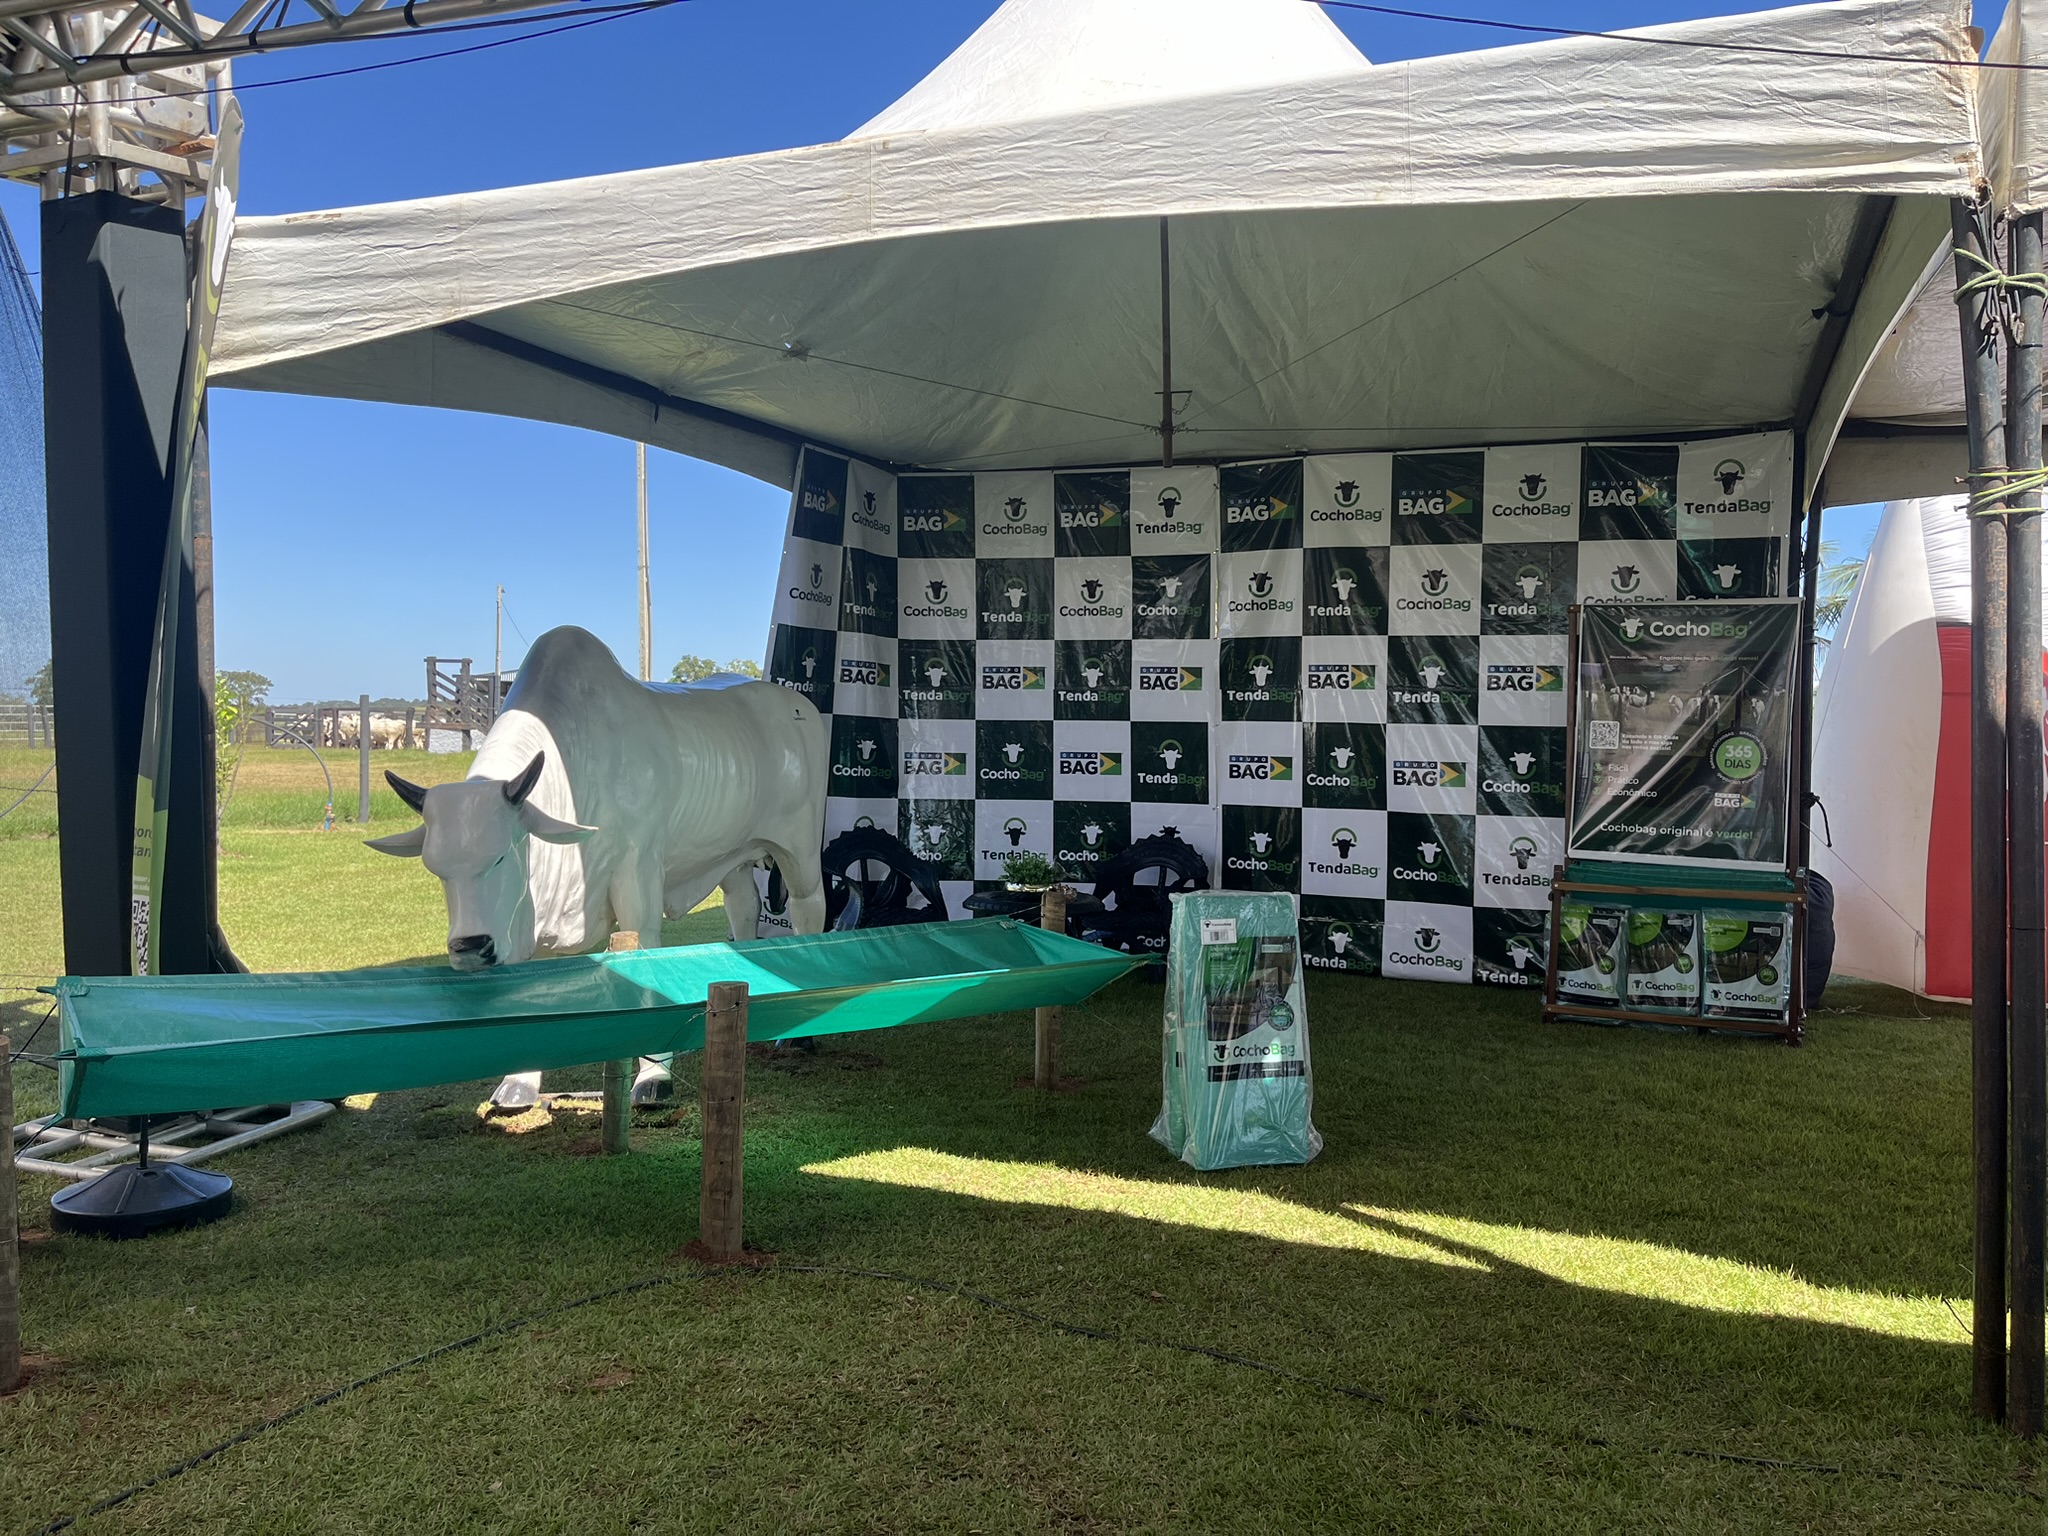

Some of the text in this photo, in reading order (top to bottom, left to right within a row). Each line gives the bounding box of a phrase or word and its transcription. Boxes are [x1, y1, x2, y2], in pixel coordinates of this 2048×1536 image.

[804, 491, 826, 512] BAG
[1588, 488, 1637, 508] BAG
[1227, 504, 1269, 523] BAG
[1398, 498, 1444, 515] BAG
[1492, 503, 1572, 517] CochoBag
[1684, 500, 1772, 514] TendaBag
[1060, 511, 1099, 528] BAG
[1310, 509, 1382, 522] CochoBag
[852, 512, 890, 535] CochoBag
[903, 516, 942, 532] BAG
[982, 523, 1048, 536] CochoBag
[1136, 522, 1202, 534] TendaBag
[789, 587, 833, 606] CochoBag
[1059, 605, 1124, 618] CochoBag
[1228, 599, 1294, 612] CochoBag
[1308, 605, 1381, 618] TendaBag
[1396, 598, 1471, 612] CochoBag
[903, 606, 968, 619] CochoBag
[982, 611, 1048, 624] TendaBag
[1650, 621, 1748, 639] CochoBag
[840, 669, 876, 685] BAG
[982, 675, 1021, 689] BAG
[1140, 675, 1178, 690] BAG
[1308, 673, 1349, 689] BAG
[1487, 675, 1534, 691] BAG
[903, 690, 970, 702] TendaBag
[1058, 691, 1123, 703] TendaBag
[1227, 691, 1295, 701] TendaBag
[1726, 746, 1752, 758] 365
[903, 760, 942, 775] BAG
[1060, 760, 1098, 775] BAG
[1609, 764, 1628, 772] Fácil
[1724, 759, 1751, 769] DIAS
[833, 765, 892, 779] CochoBag
[980, 768, 1044, 781] CochoBag
[1229, 764, 1269, 780] BAG
[1393, 770, 1437, 786] BAG
[1138, 773, 1203, 786] TendaBag
[1306, 774, 1376, 789] CochoBag
[1608, 776, 1639, 784] Prático
[1482, 780, 1560, 798] CochoBag
[1607, 788, 1657, 797] Econômico
[1714, 798, 1739, 807] BAG
[1600, 822, 1753, 840] Cochobag original é verde!
[1228, 858, 1293, 873] CochoBag
[1308, 862, 1379, 878] TendaBag
[1483, 873, 1550, 886] TendaBa
[1303, 954, 1374, 972] TendaBag
[1390, 953, 1463, 970] CochoBag
[1568, 980, 1614, 993] CochoBag
[1645, 981, 1695, 992] CochoBag
[1725, 992, 1777, 1004] CochoBag
[1233, 1044, 1295, 1057] CochoBag
